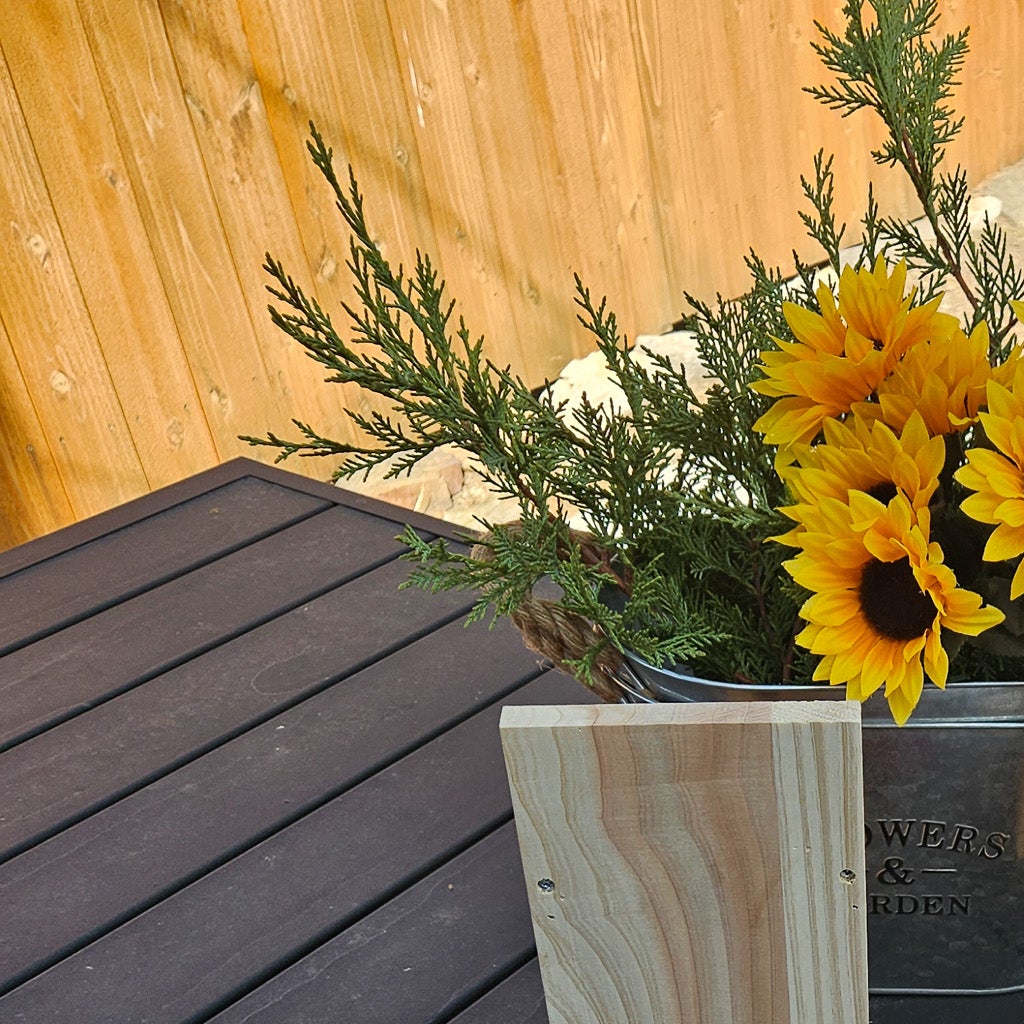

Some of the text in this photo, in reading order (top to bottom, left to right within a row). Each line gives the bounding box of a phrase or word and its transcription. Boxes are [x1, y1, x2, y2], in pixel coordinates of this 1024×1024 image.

[864, 818, 1010, 859] WERS
[876, 856, 915, 885] &
[867, 893, 972, 916] RDEN
